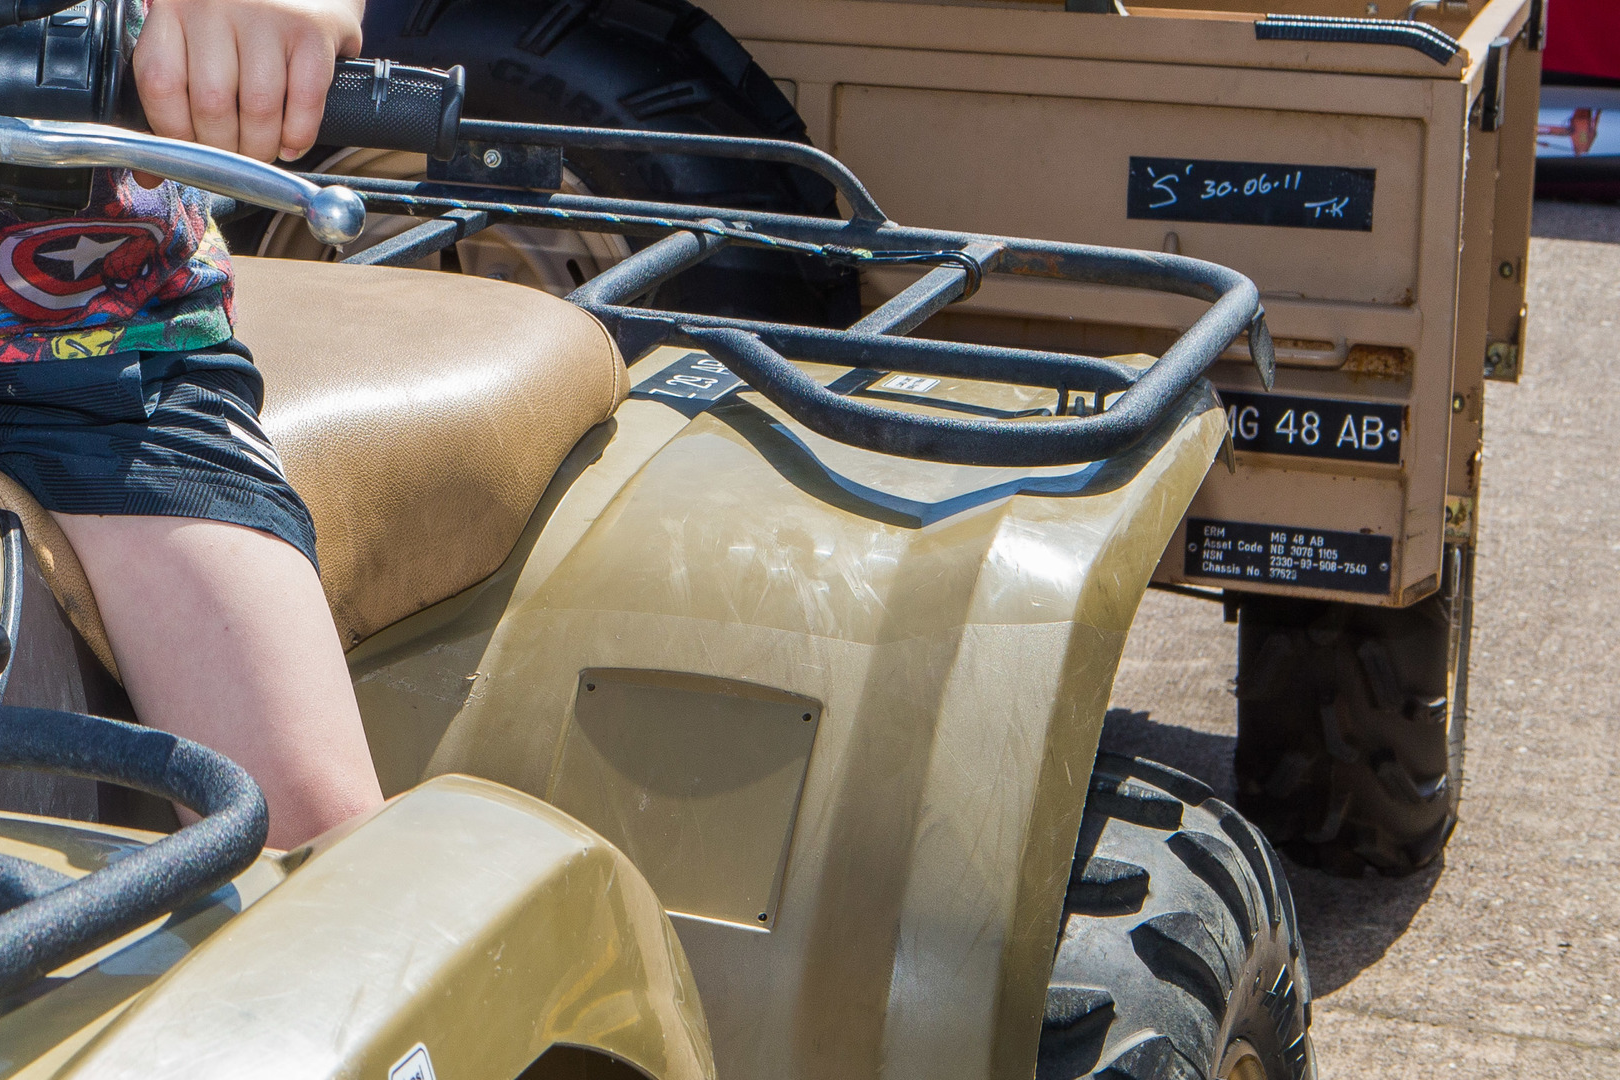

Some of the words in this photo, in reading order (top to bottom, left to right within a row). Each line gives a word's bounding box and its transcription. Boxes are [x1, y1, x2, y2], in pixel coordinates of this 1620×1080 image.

[1201, 171, 1301, 199] 30.06.11
[1275, 409, 1320, 445] 48
[1336, 414, 1384, 450] AB
[1204, 526, 1225, 537] ERM
[1270, 531, 1287, 544] MG
[1292, 534, 1305, 545] 48
[1310, 535, 1324, 547] AB
[1202, 549, 1224, 561] NSN
[1203, 538, 1232, 550] Asset
[1238, 540, 1263, 553] Code
[1318, 548, 1338, 560] 1105
[1202, 561, 1241, 575] Chassis
